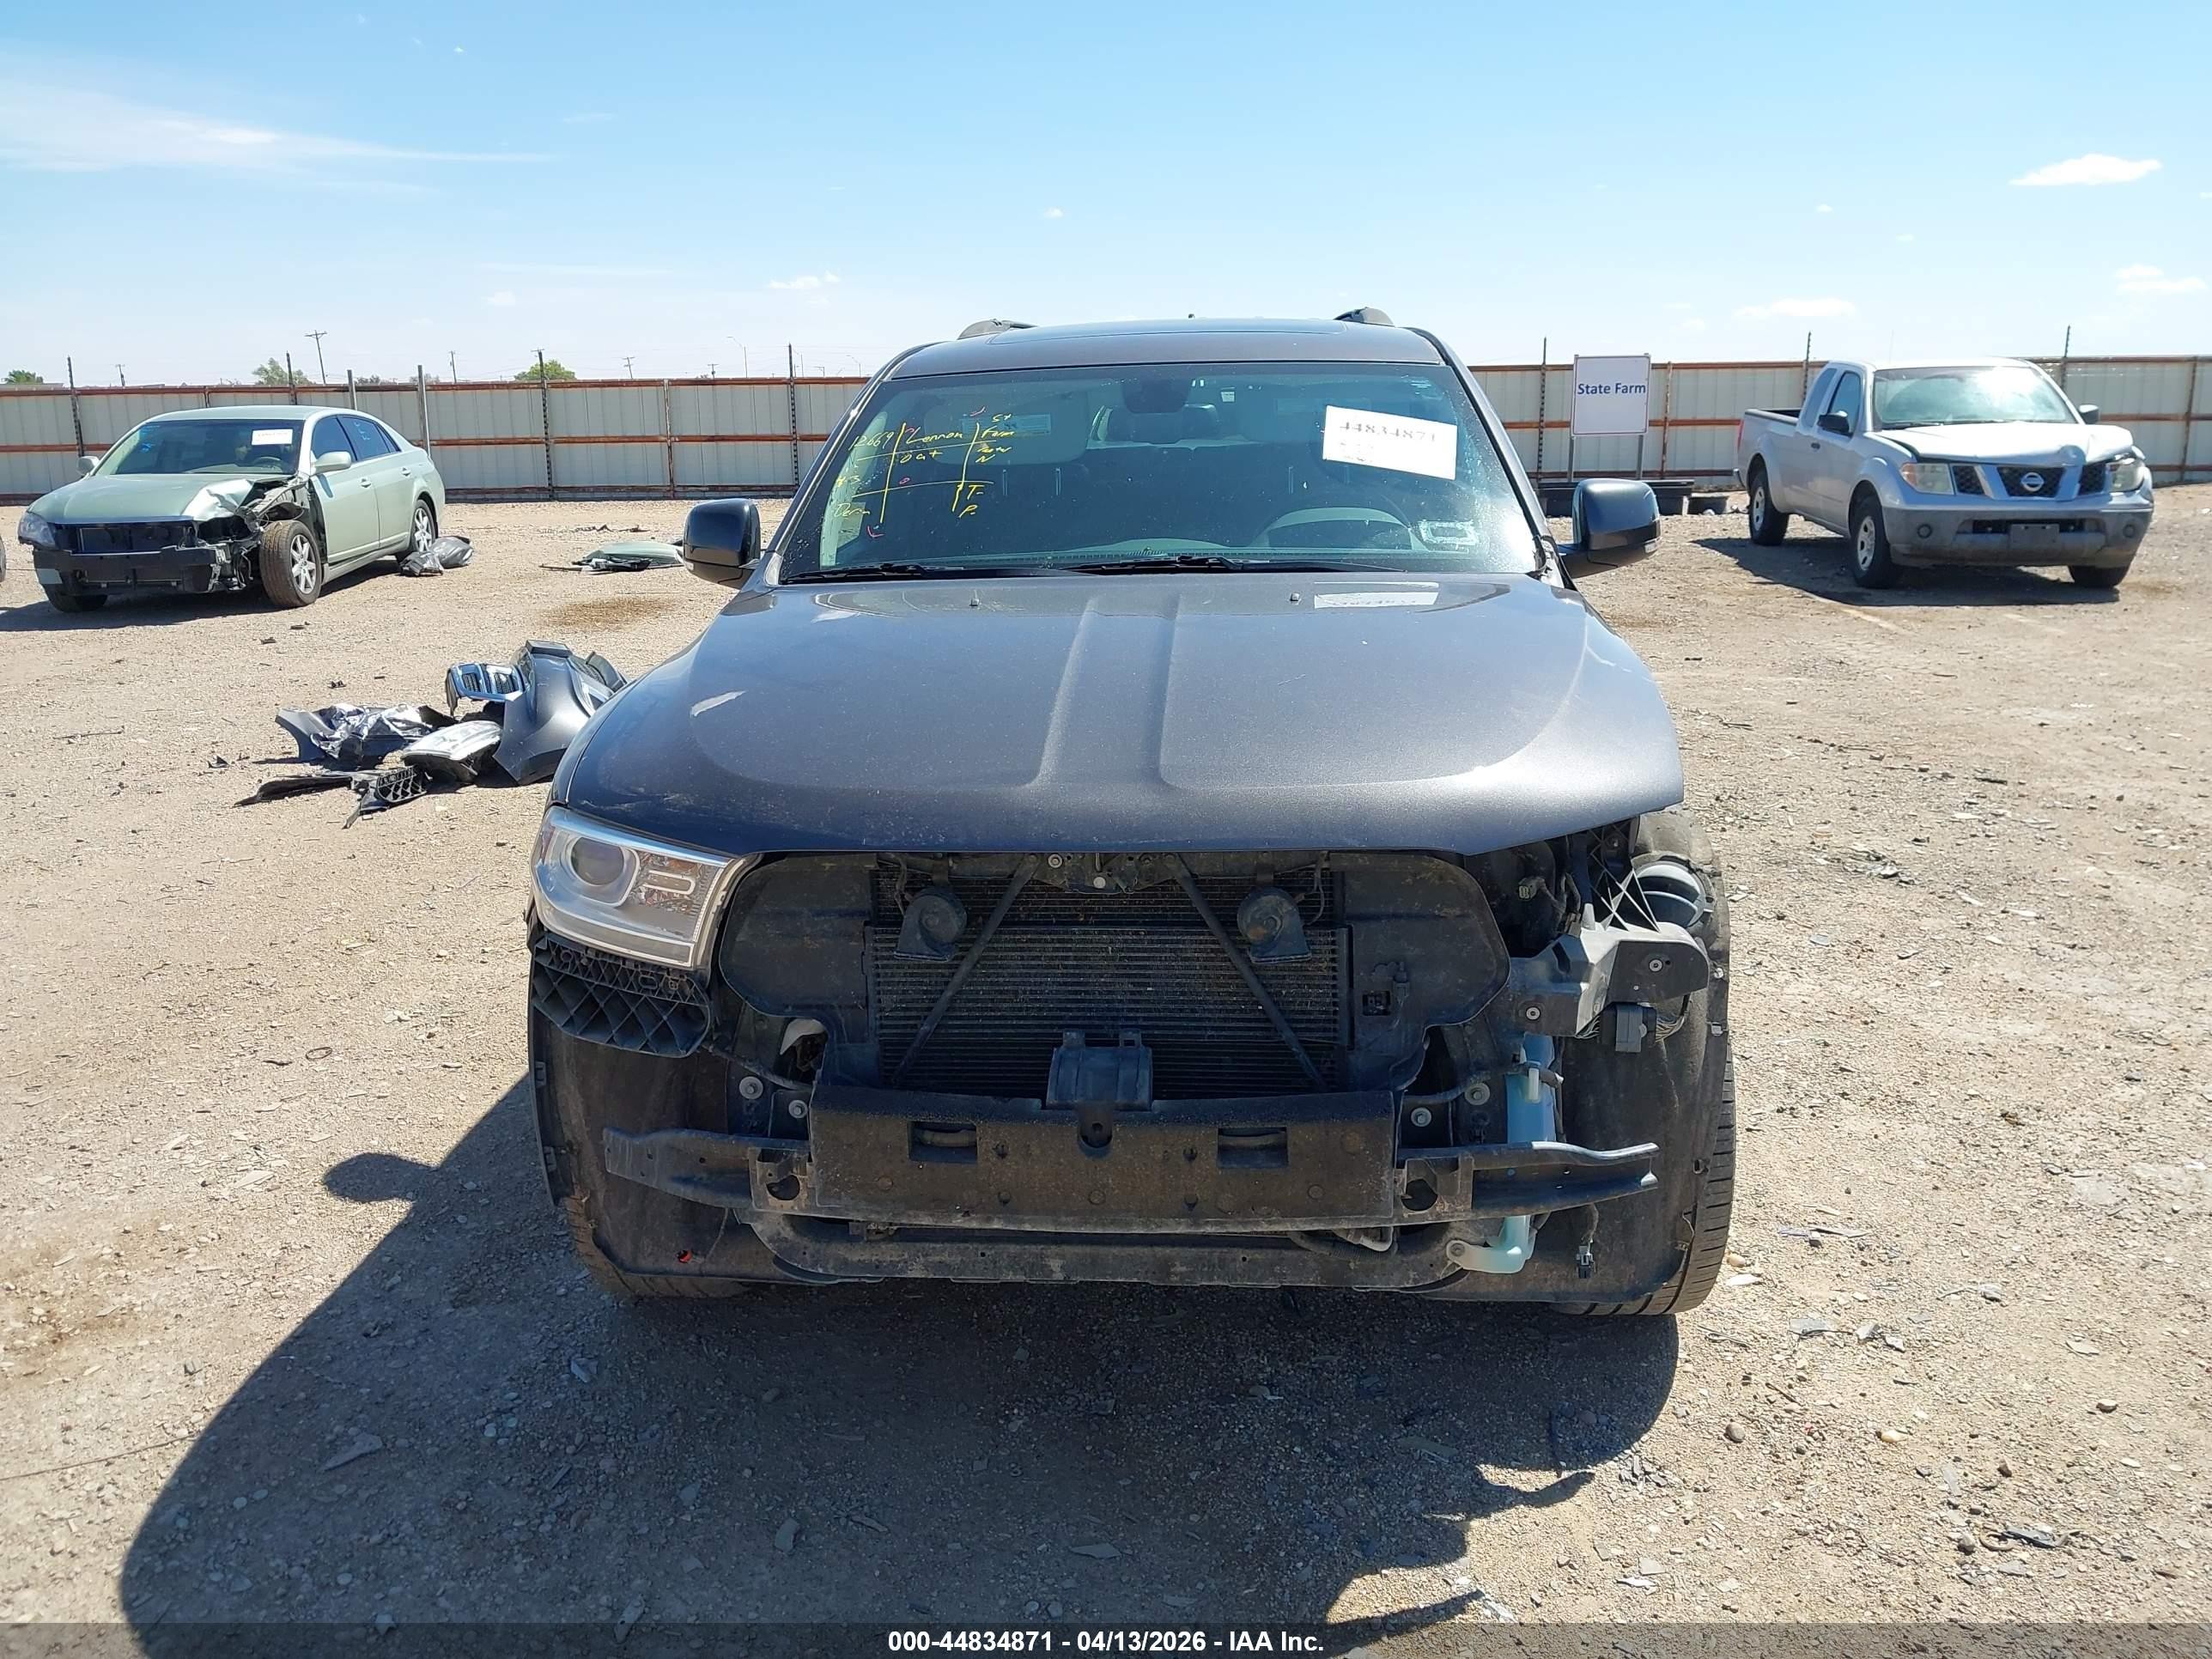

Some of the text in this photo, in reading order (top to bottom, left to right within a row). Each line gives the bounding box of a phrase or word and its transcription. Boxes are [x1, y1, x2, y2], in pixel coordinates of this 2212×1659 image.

[1577, 382, 1646, 395] State Farm
[1339, 420, 1437, 442] 44834871
